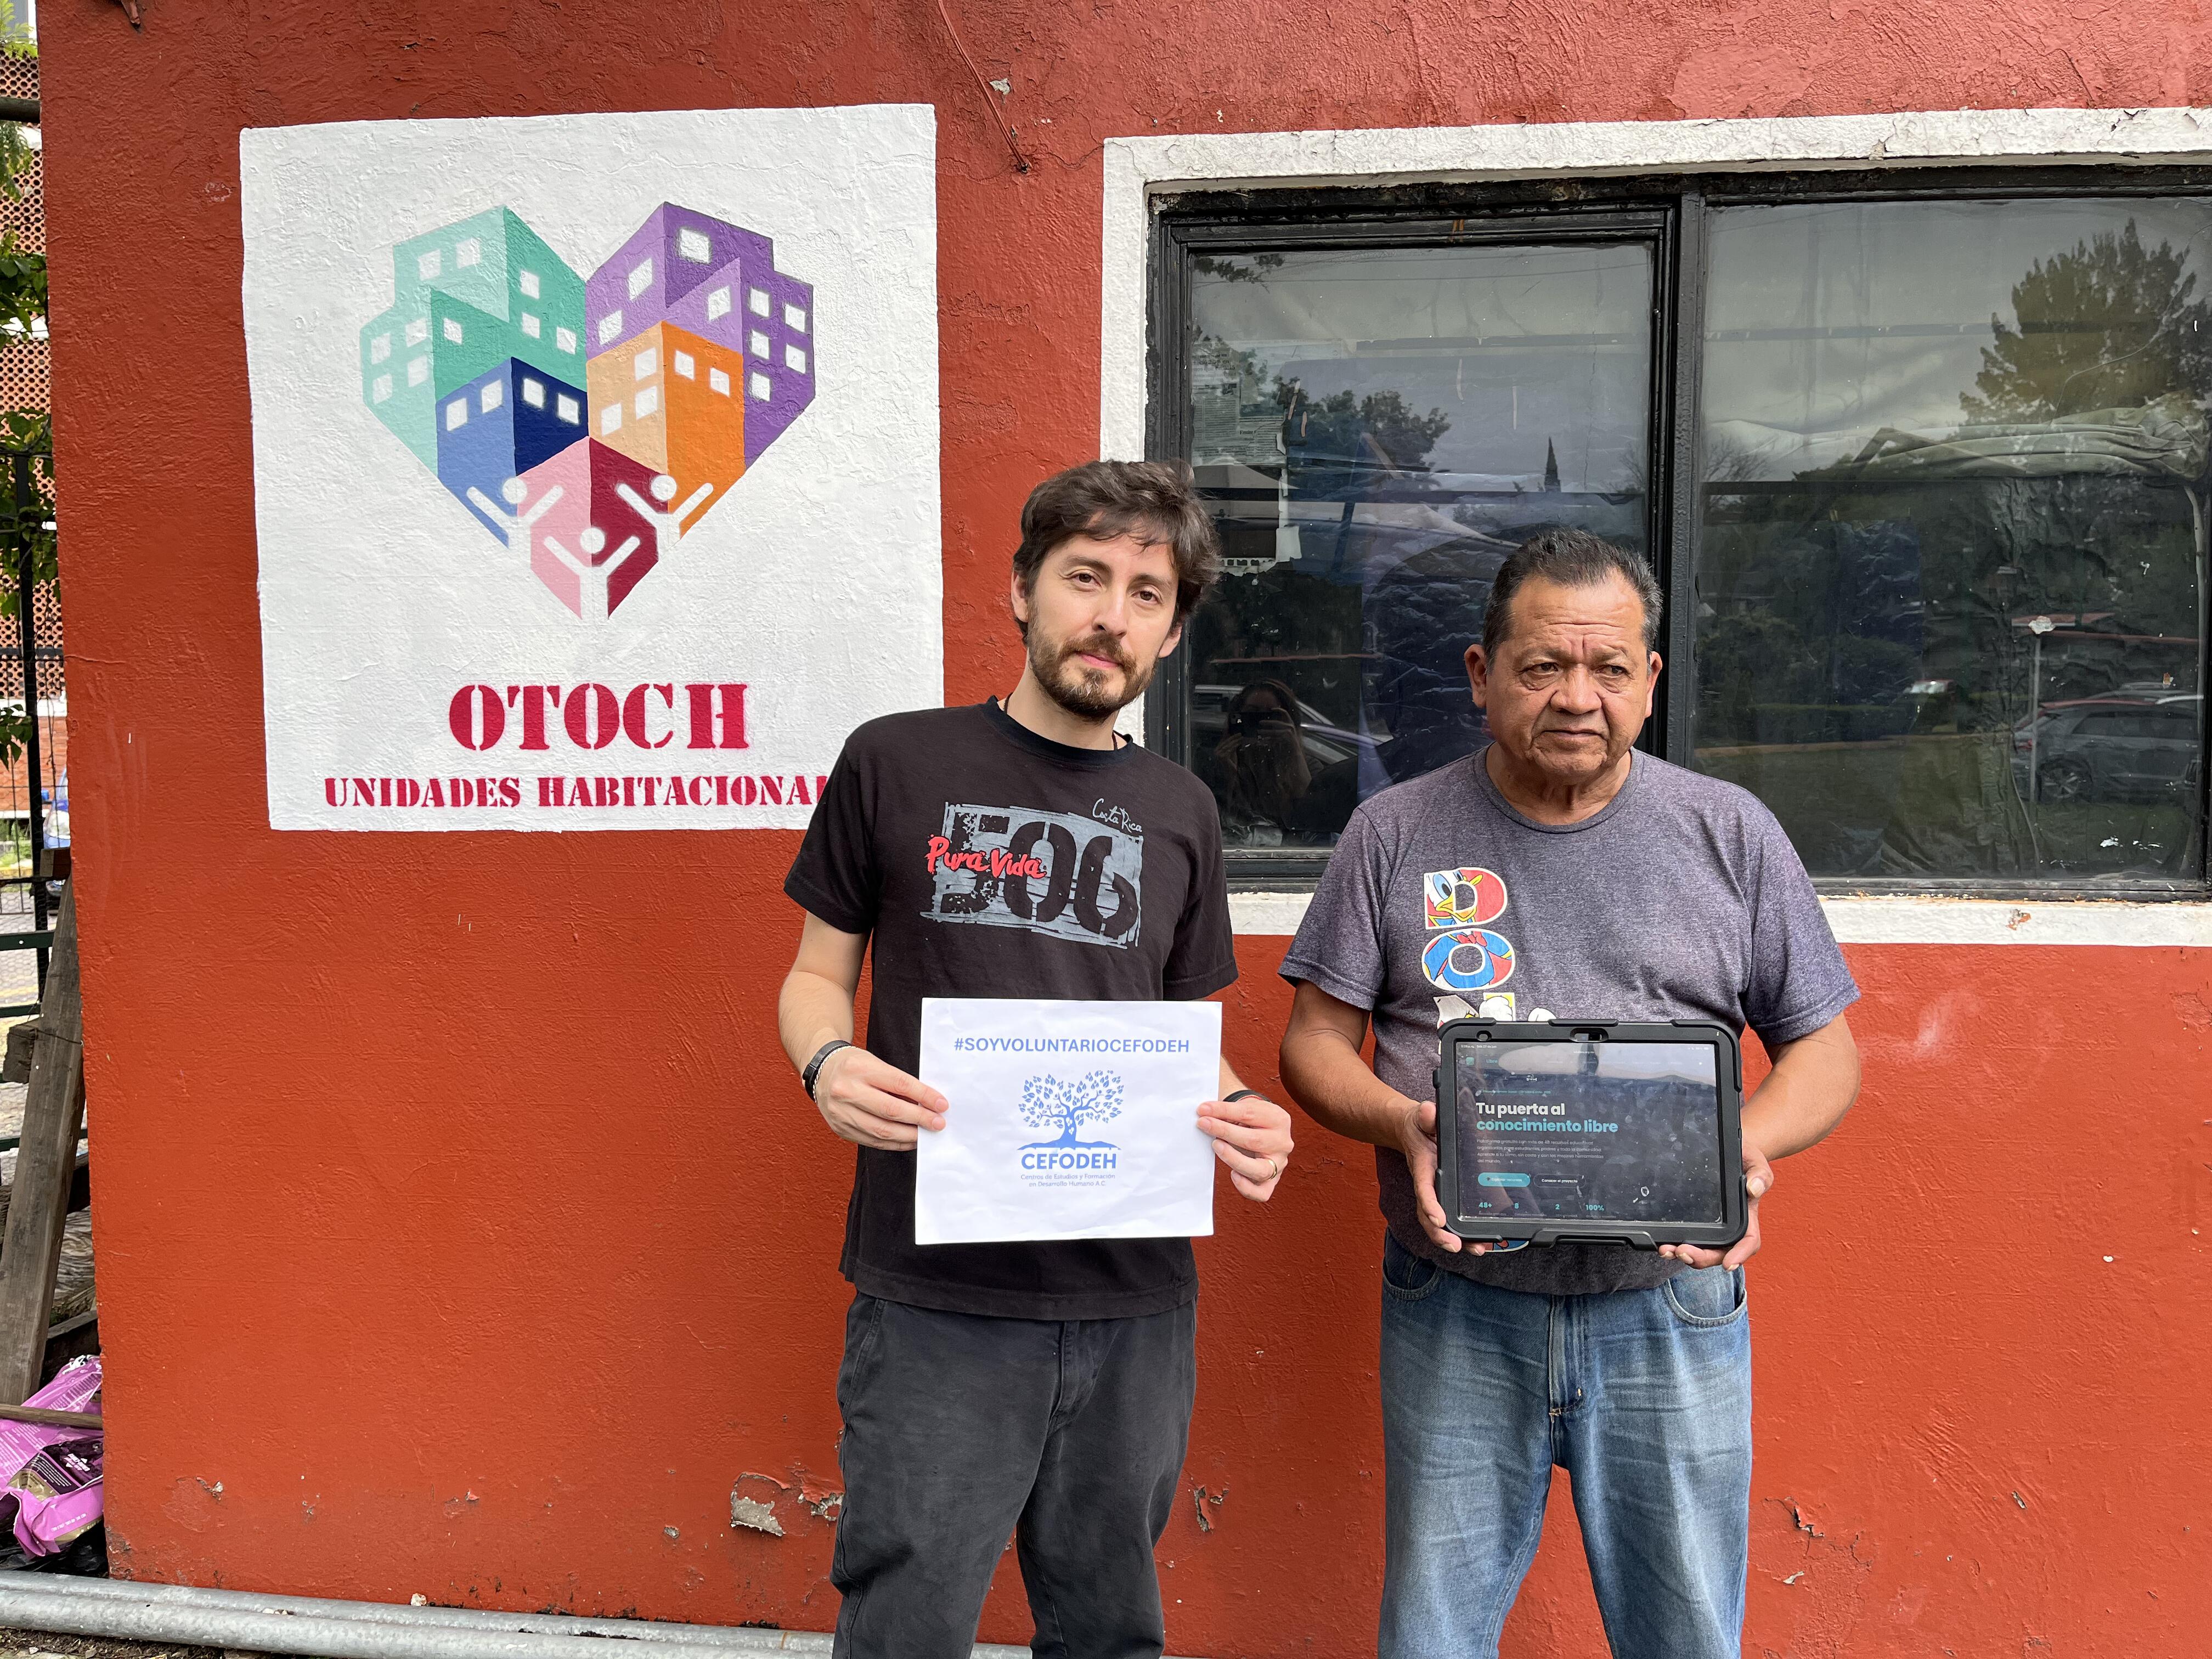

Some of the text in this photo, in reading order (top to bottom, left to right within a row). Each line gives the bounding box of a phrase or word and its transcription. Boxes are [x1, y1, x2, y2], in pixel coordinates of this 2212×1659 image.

[449, 683, 749, 751] OTOCH
[324, 777, 521, 808] UNIDADES
[1119, 807, 1142, 833] Rica
[926, 834, 1047, 878] Pura Vida
[954, 1038, 1189, 1053] #SOYVOLUNTARIOCEFODEH
[1476, 1102, 1565, 1118] Tu puerta al
[1476, 1118, 1618, 1133] conocimiento libre
[1021, 1153, 1116, 1169] CEFODEH
